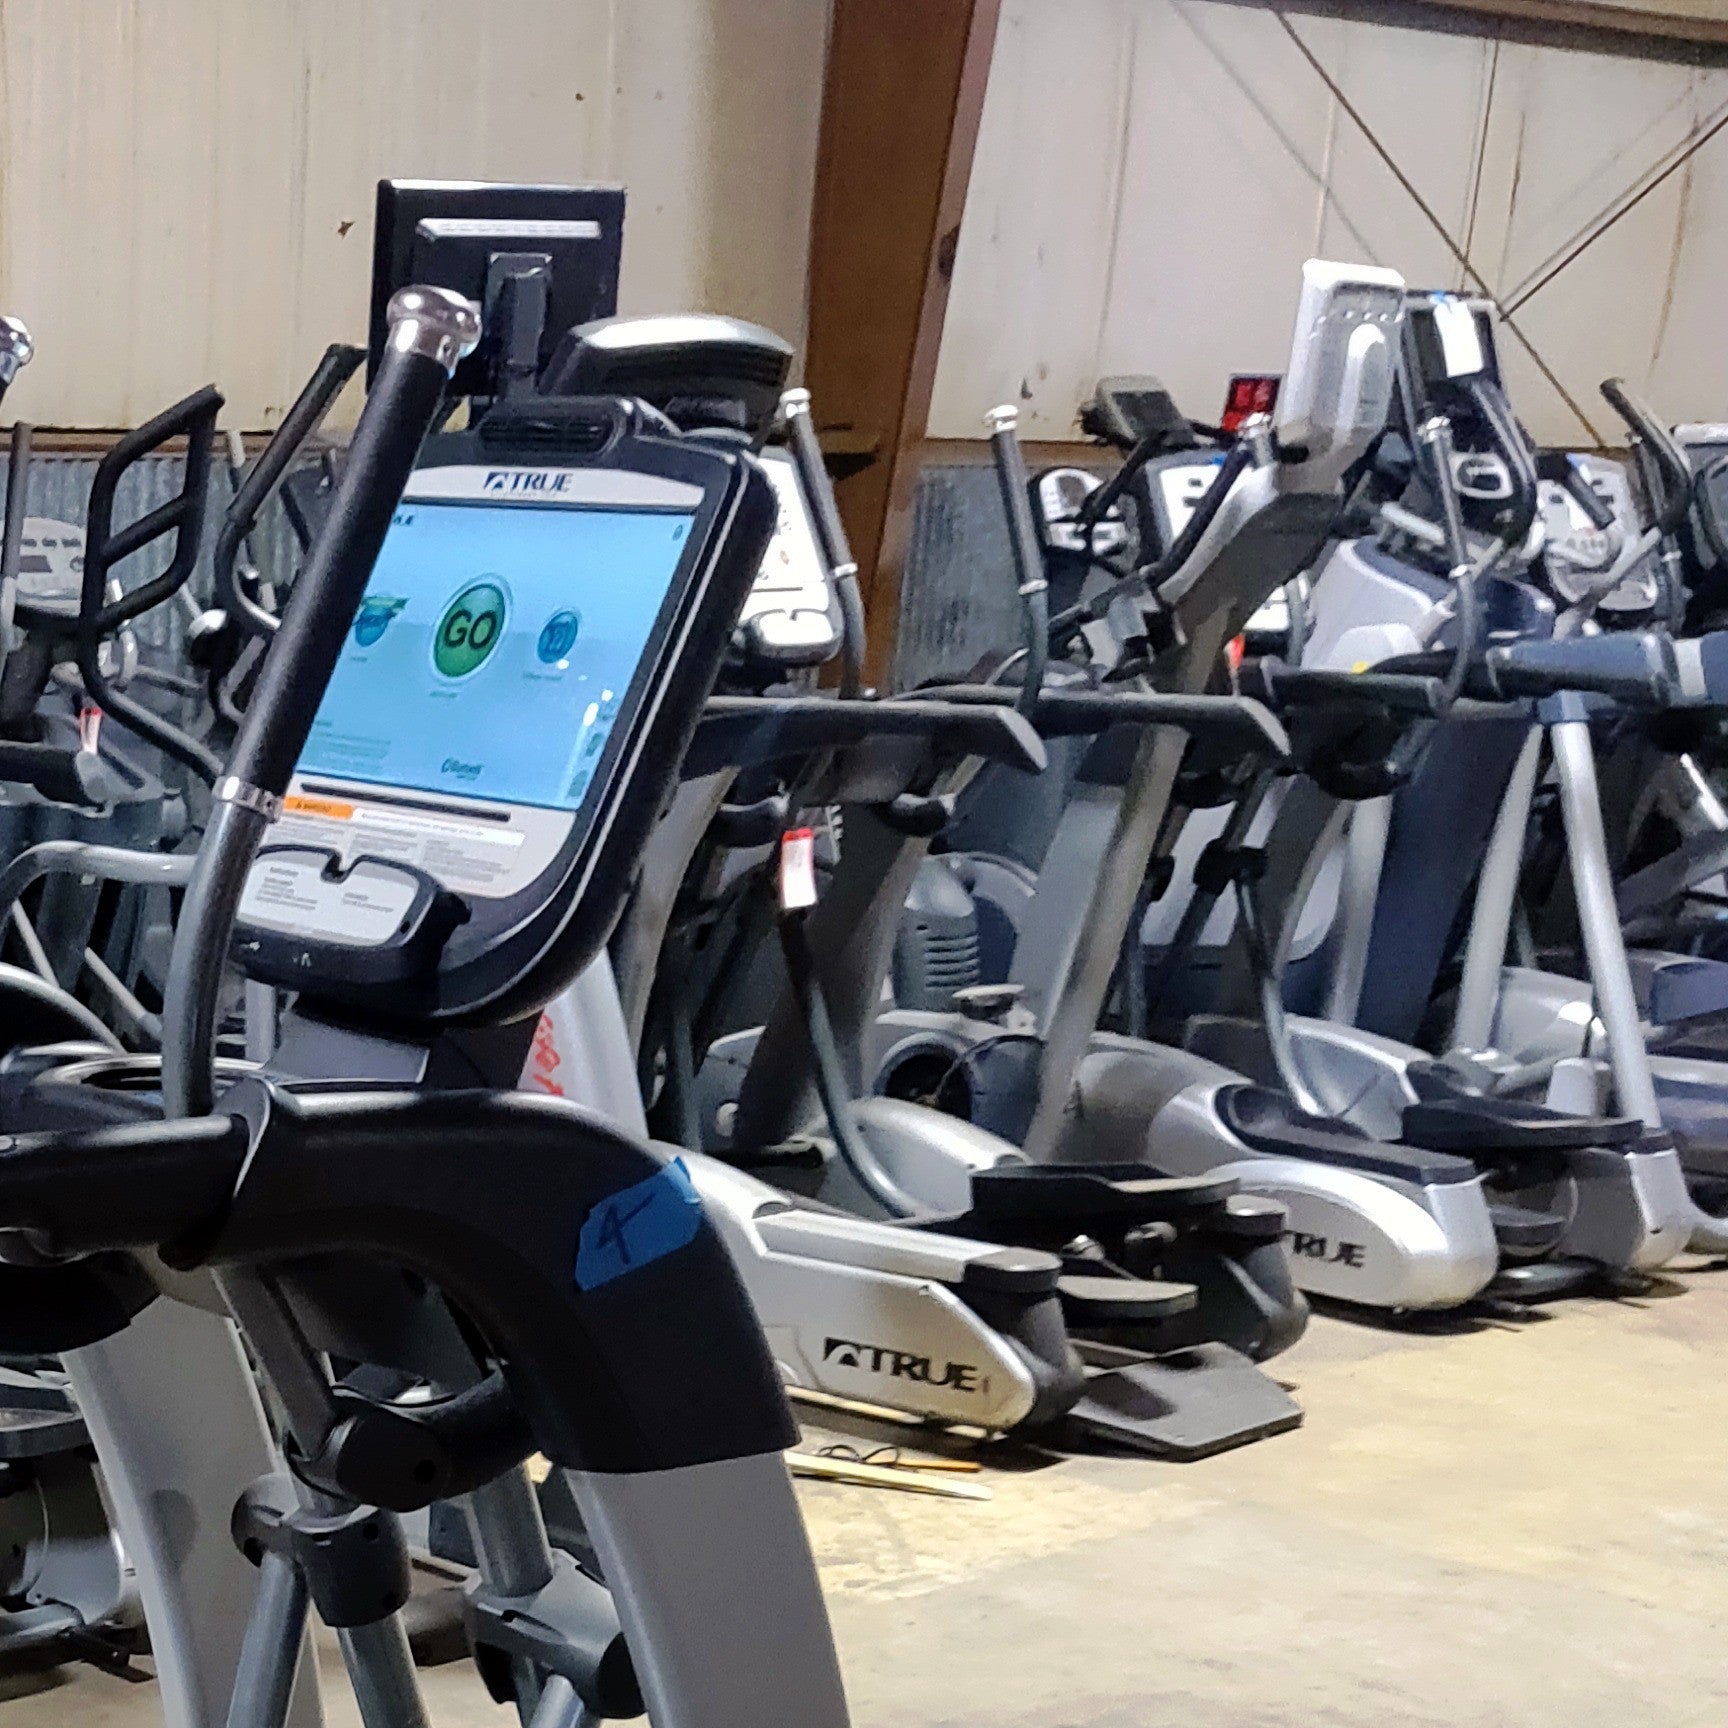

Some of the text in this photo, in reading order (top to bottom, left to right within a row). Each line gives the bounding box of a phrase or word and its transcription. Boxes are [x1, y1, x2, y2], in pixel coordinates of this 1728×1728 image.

[512, 472, 573, 492] TRUE
[444, 608, 497, 650] GO
[1280, 1229, 1367, 1269] RUE
[858, 1344, 978, 1392] TRUE
